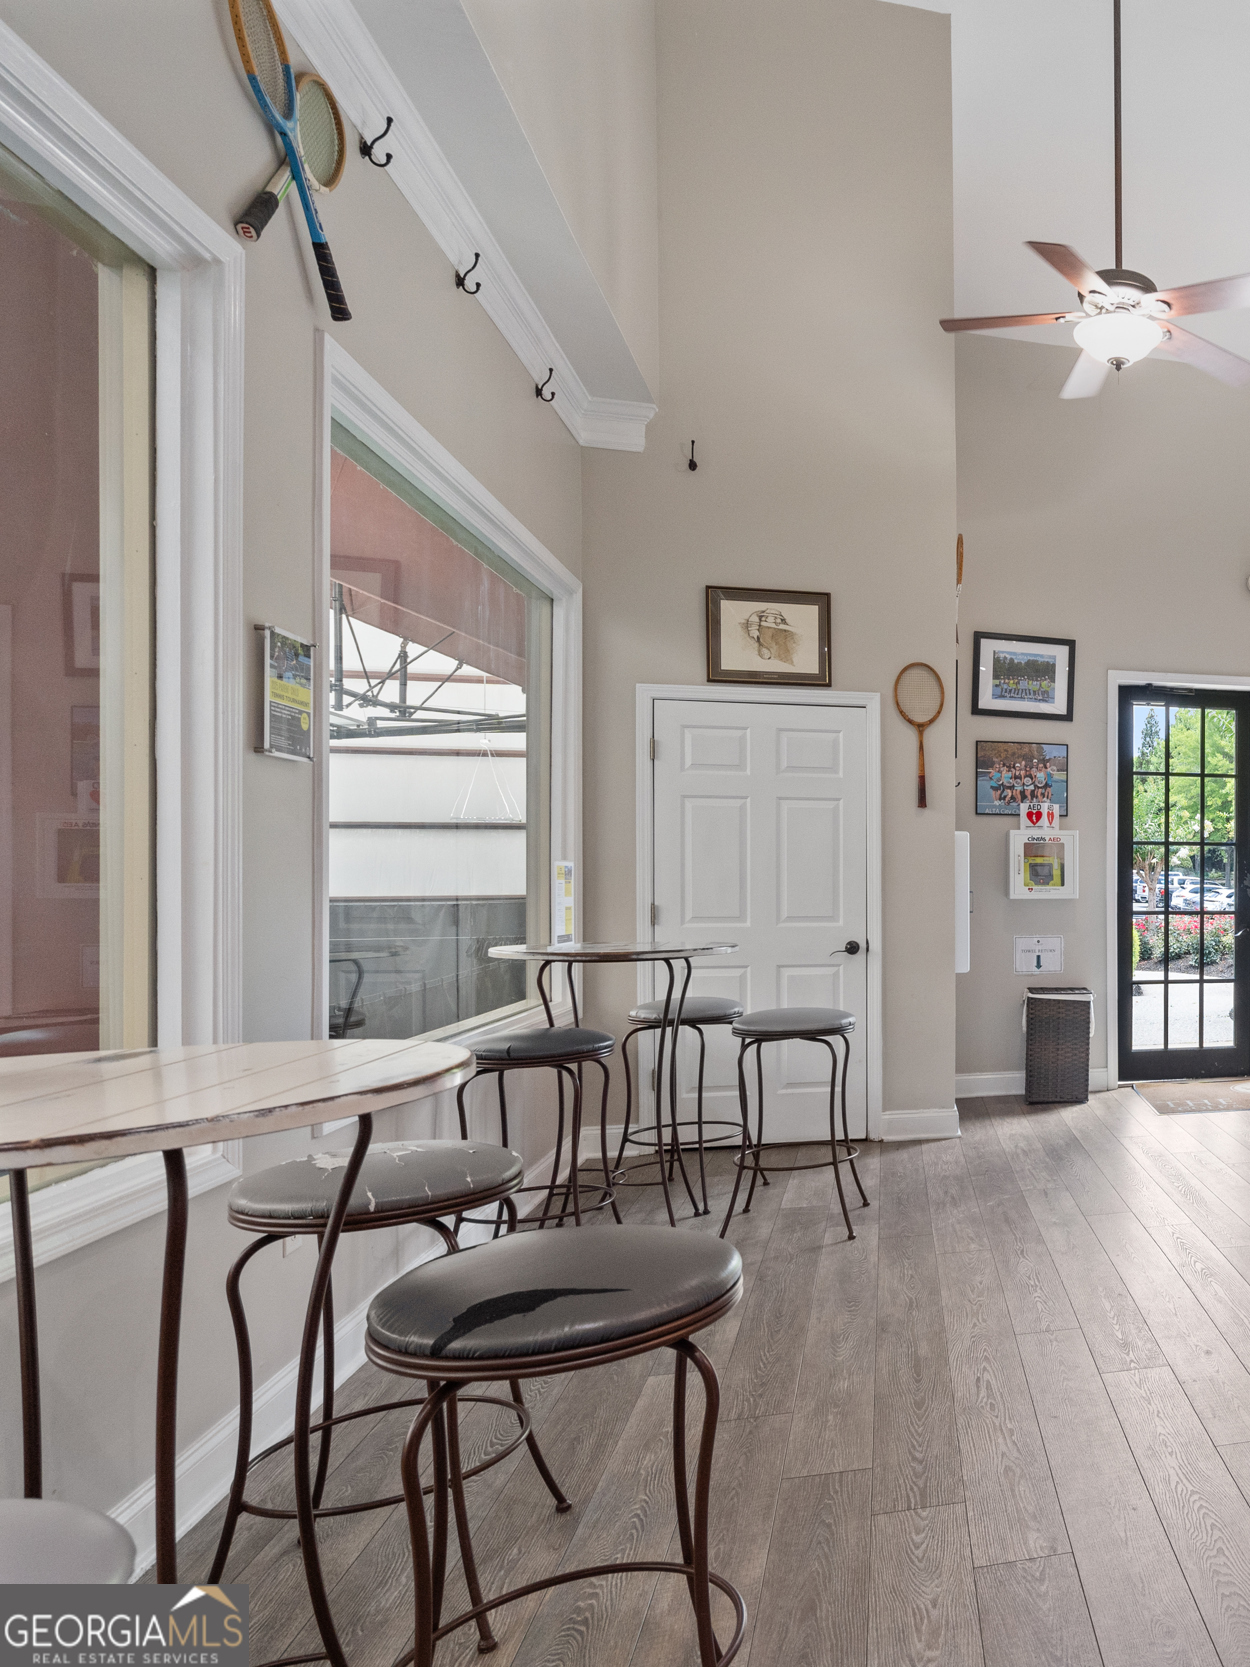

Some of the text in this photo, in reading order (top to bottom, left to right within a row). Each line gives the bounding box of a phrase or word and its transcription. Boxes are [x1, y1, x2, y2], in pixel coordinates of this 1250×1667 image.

[271, 691, 310, 708] TENNIS TOURNAMENT
[1157, 1098, 1236, 1108] THE
